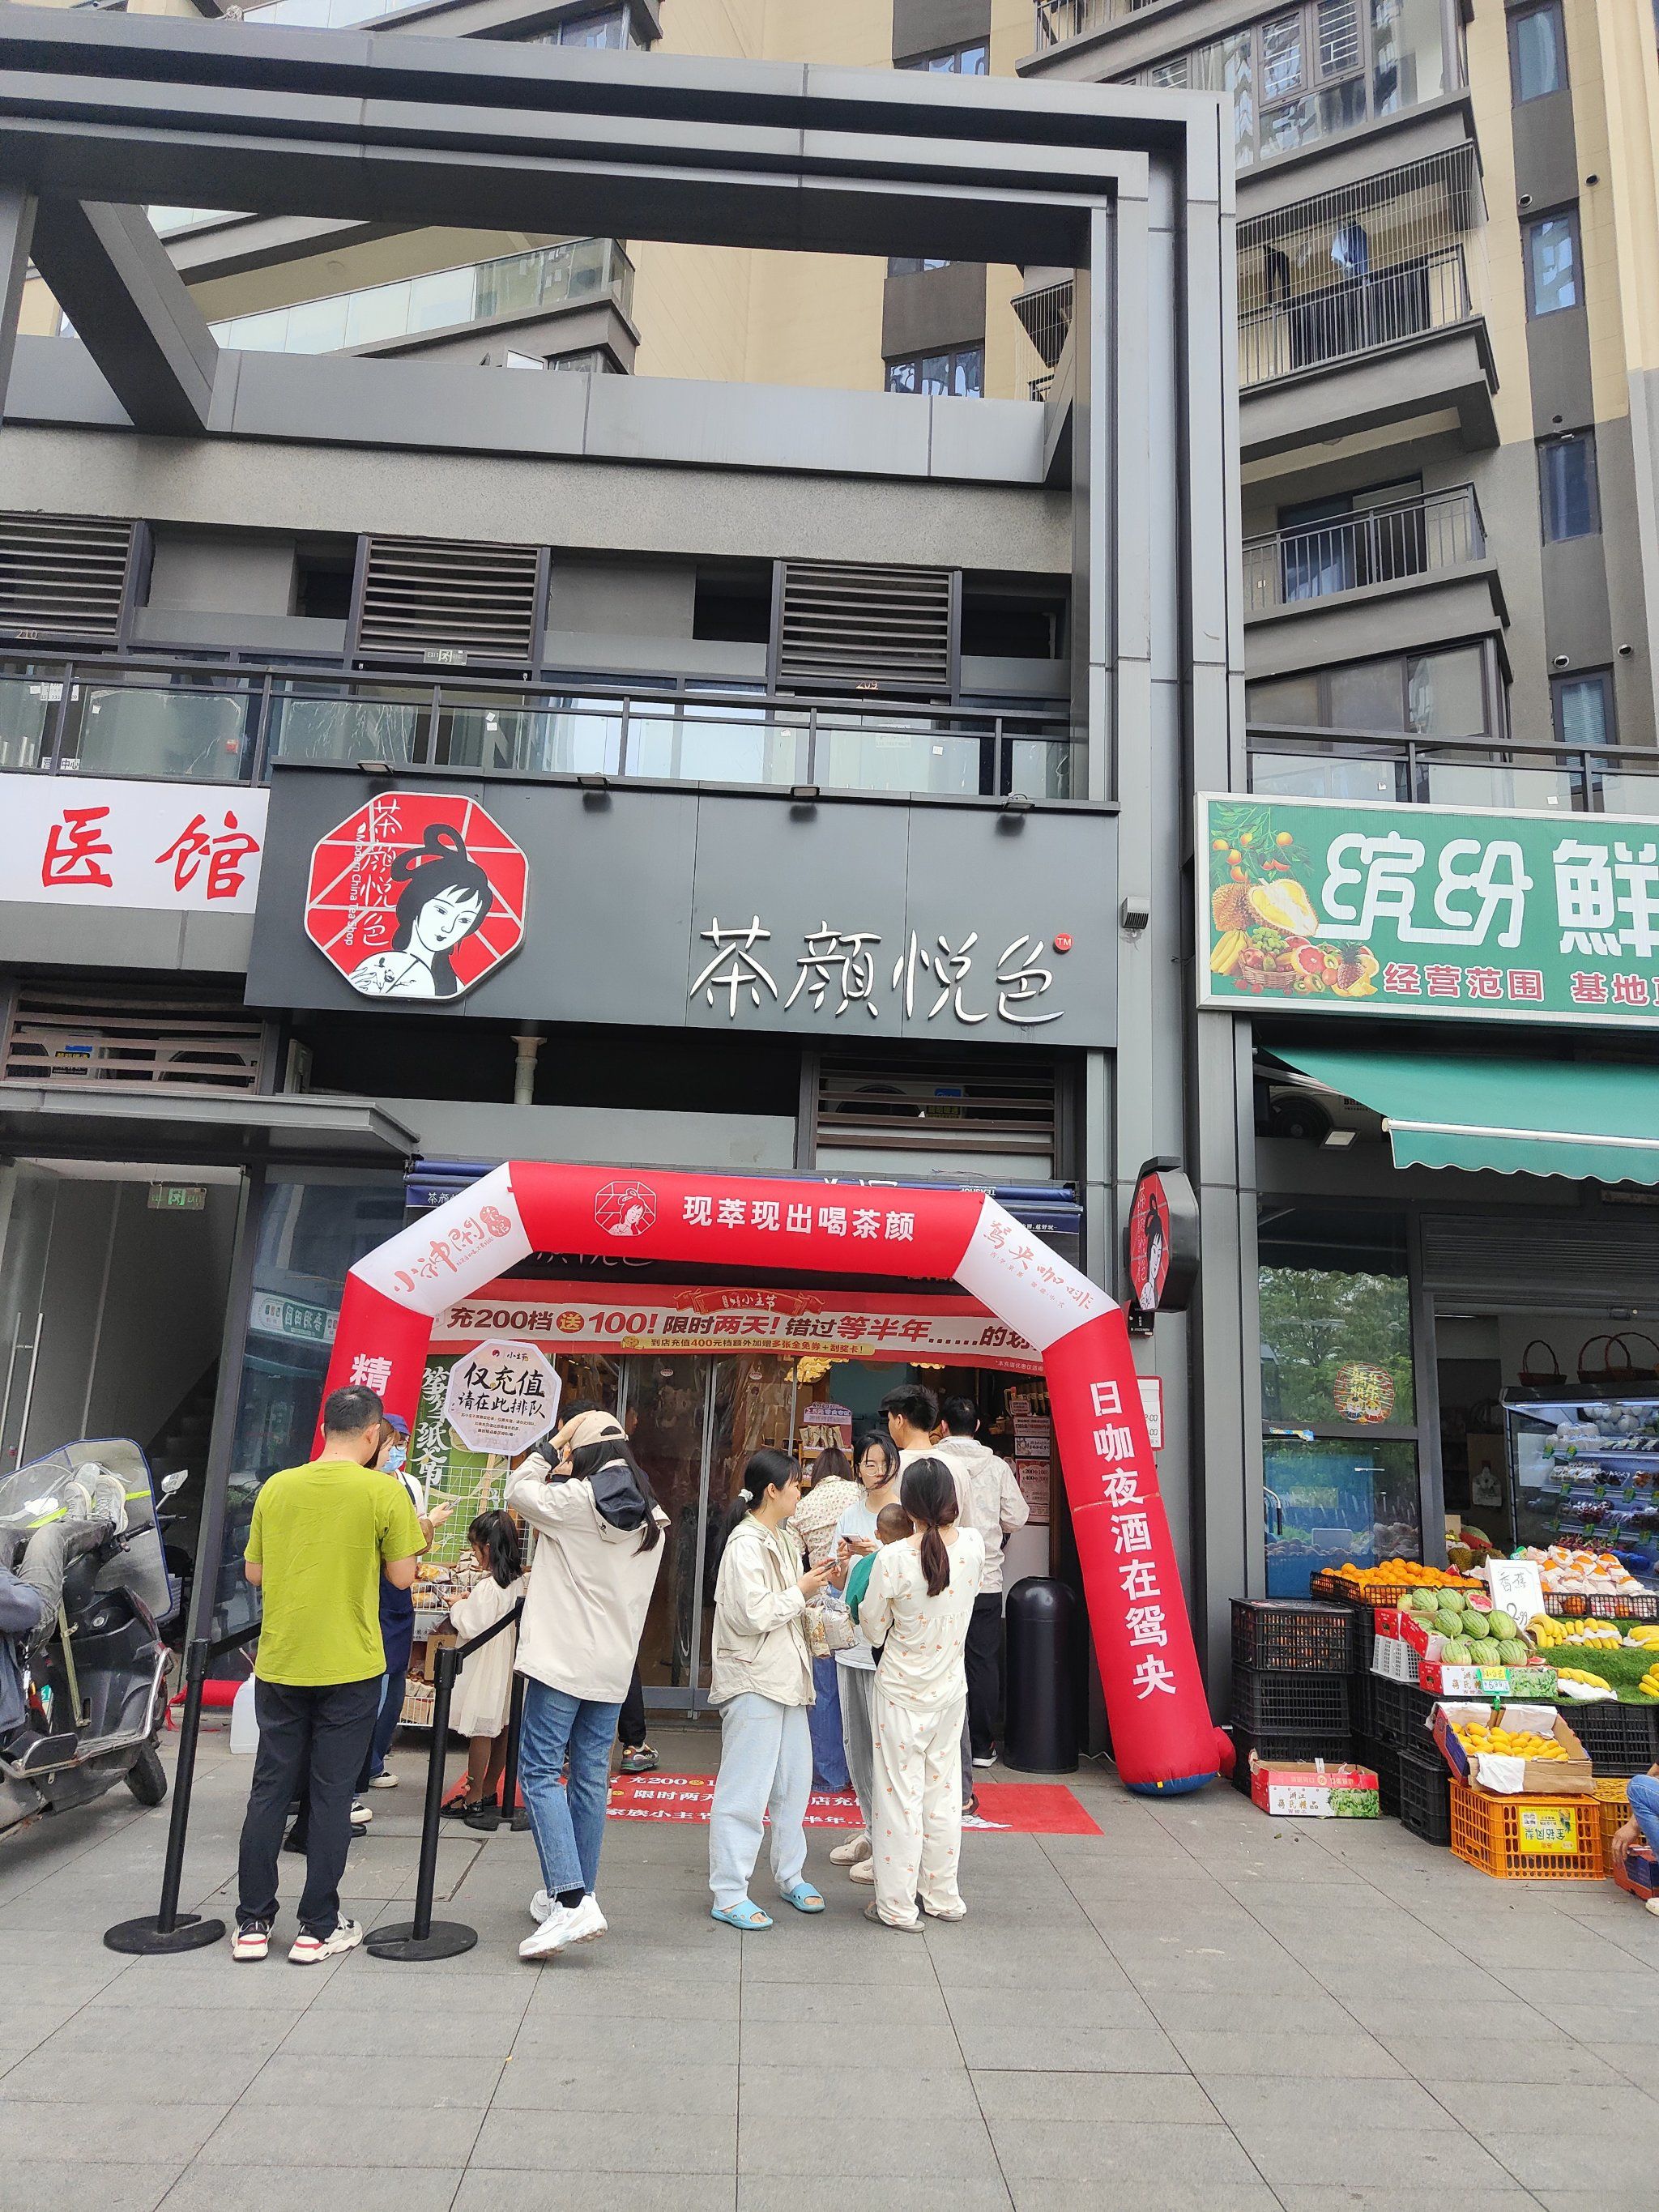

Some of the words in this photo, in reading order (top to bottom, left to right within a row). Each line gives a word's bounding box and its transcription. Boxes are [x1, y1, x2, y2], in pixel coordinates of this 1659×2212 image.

[855, 680, 879, 690] 209
[41, 806, 260, 901] 医馆
[351, 833, 366, 872] Modern
[349, 874, 362, 901] China
[360, 798, 404, 946] 茶颜悦色
[347, 903, 360, 923] Tea
[343, 921, 358, 946] Shop
[689, 914, 1066, 1025] 茶颜悦色
[1384, 961, 1546, 1002] 经营范围
[1570, 971, 1659, 1007] 基地
[427, 1191, 458, 1205] 茶颜
[683, 1195, 915, 1242] 现萃现出喝茶颜
[506, 1351, 529, 1362] 小主节
[463, 1361, 546, 1399] 仅充值
[457, 1390, 547, 1419] 请在此排队
[1088, 1379, 1178, 1702] 日咖夜酒在鸳央
